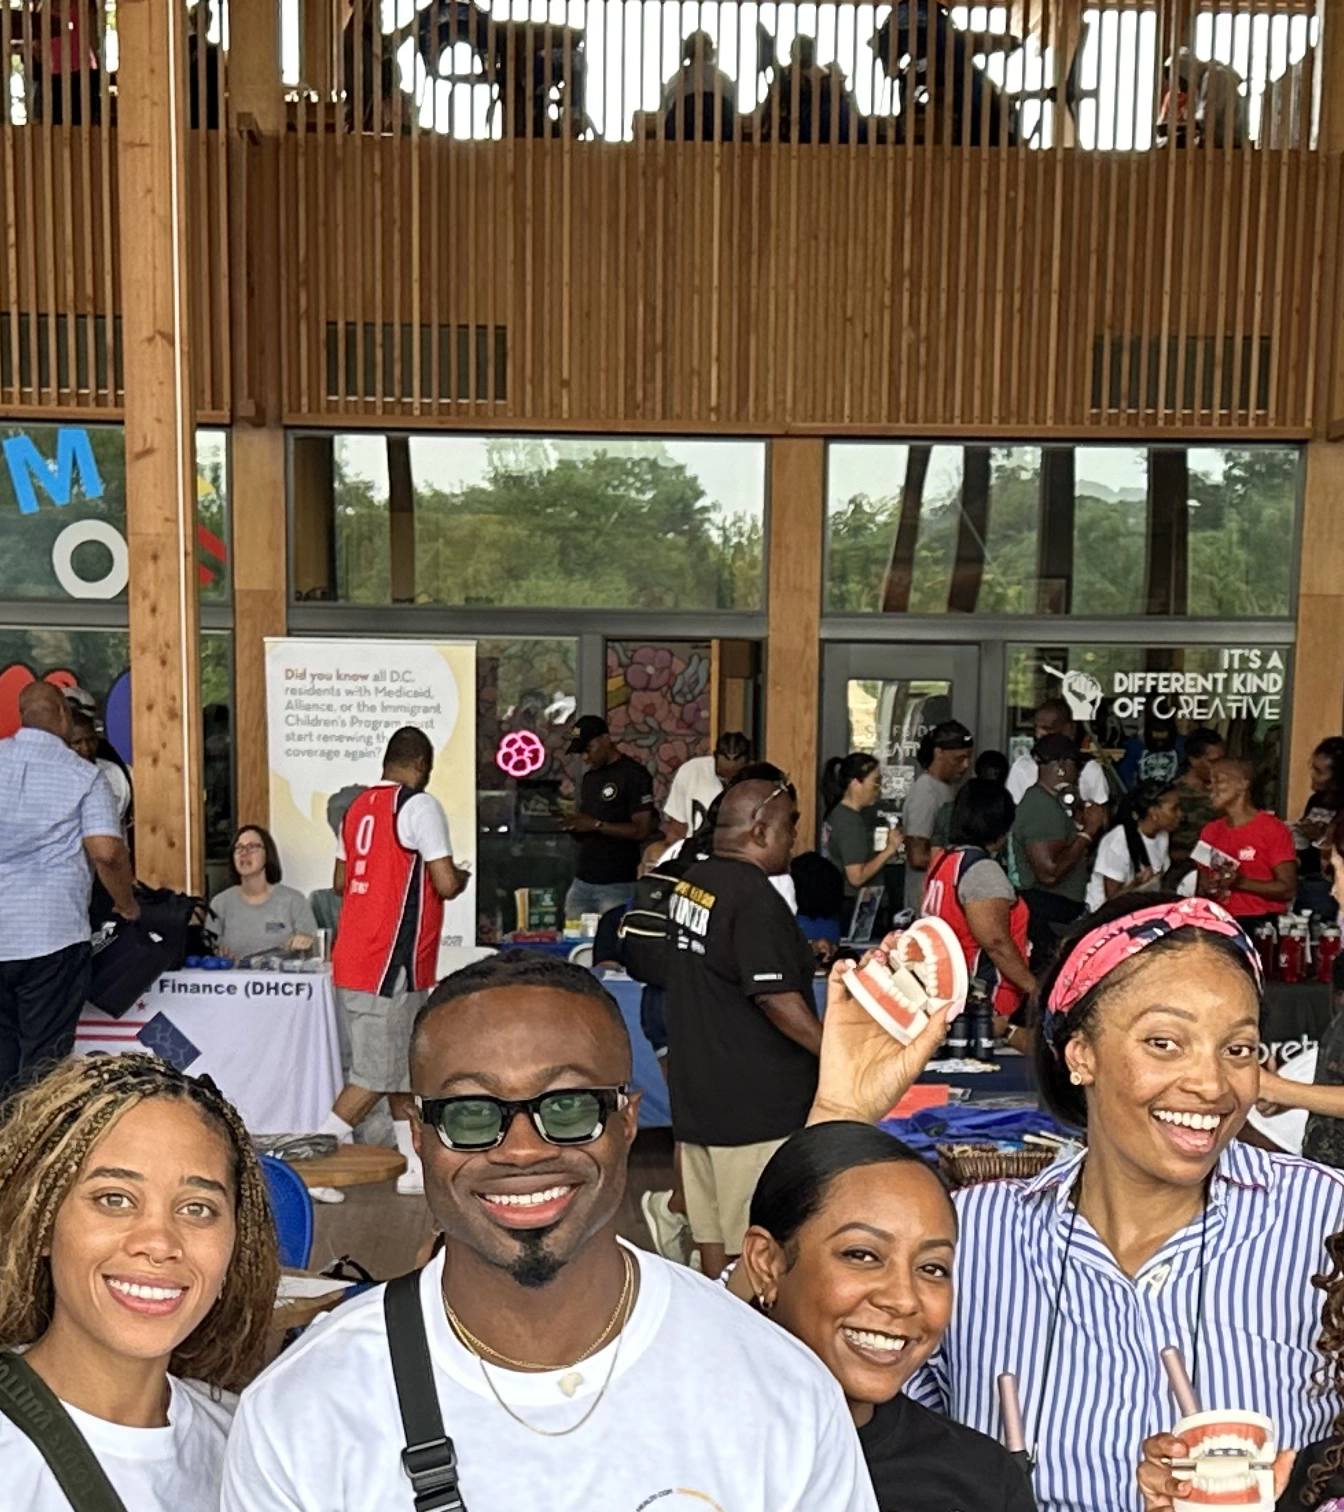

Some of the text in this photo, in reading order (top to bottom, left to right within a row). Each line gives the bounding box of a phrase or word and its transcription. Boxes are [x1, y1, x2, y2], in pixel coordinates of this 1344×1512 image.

[1223, 649, 1283, 670] IT'S A
[284, 668, 414, 684] Did you know all D.C.
[1114, 672, 1282, 693] DIFFERENT KIND
[284, 686, 434, 699] residents with Medicaid,
[284, 700, 441, 717] Alliance, or the Immigrant
[1113, 695, 1281, 720] OF CREATIVE
[284, 715, 347, 728] Children's
[350, 716, 402, 731] Program
[285, 732, 313, 742] start
[317, 733, 374, 747] renewing
[285, 748, 382, 761] coverage again?
[356, 814, 375, 856] 0
[159, 979, 237, 995] Finance
[244, 979, 314, 999] (DHCF)
